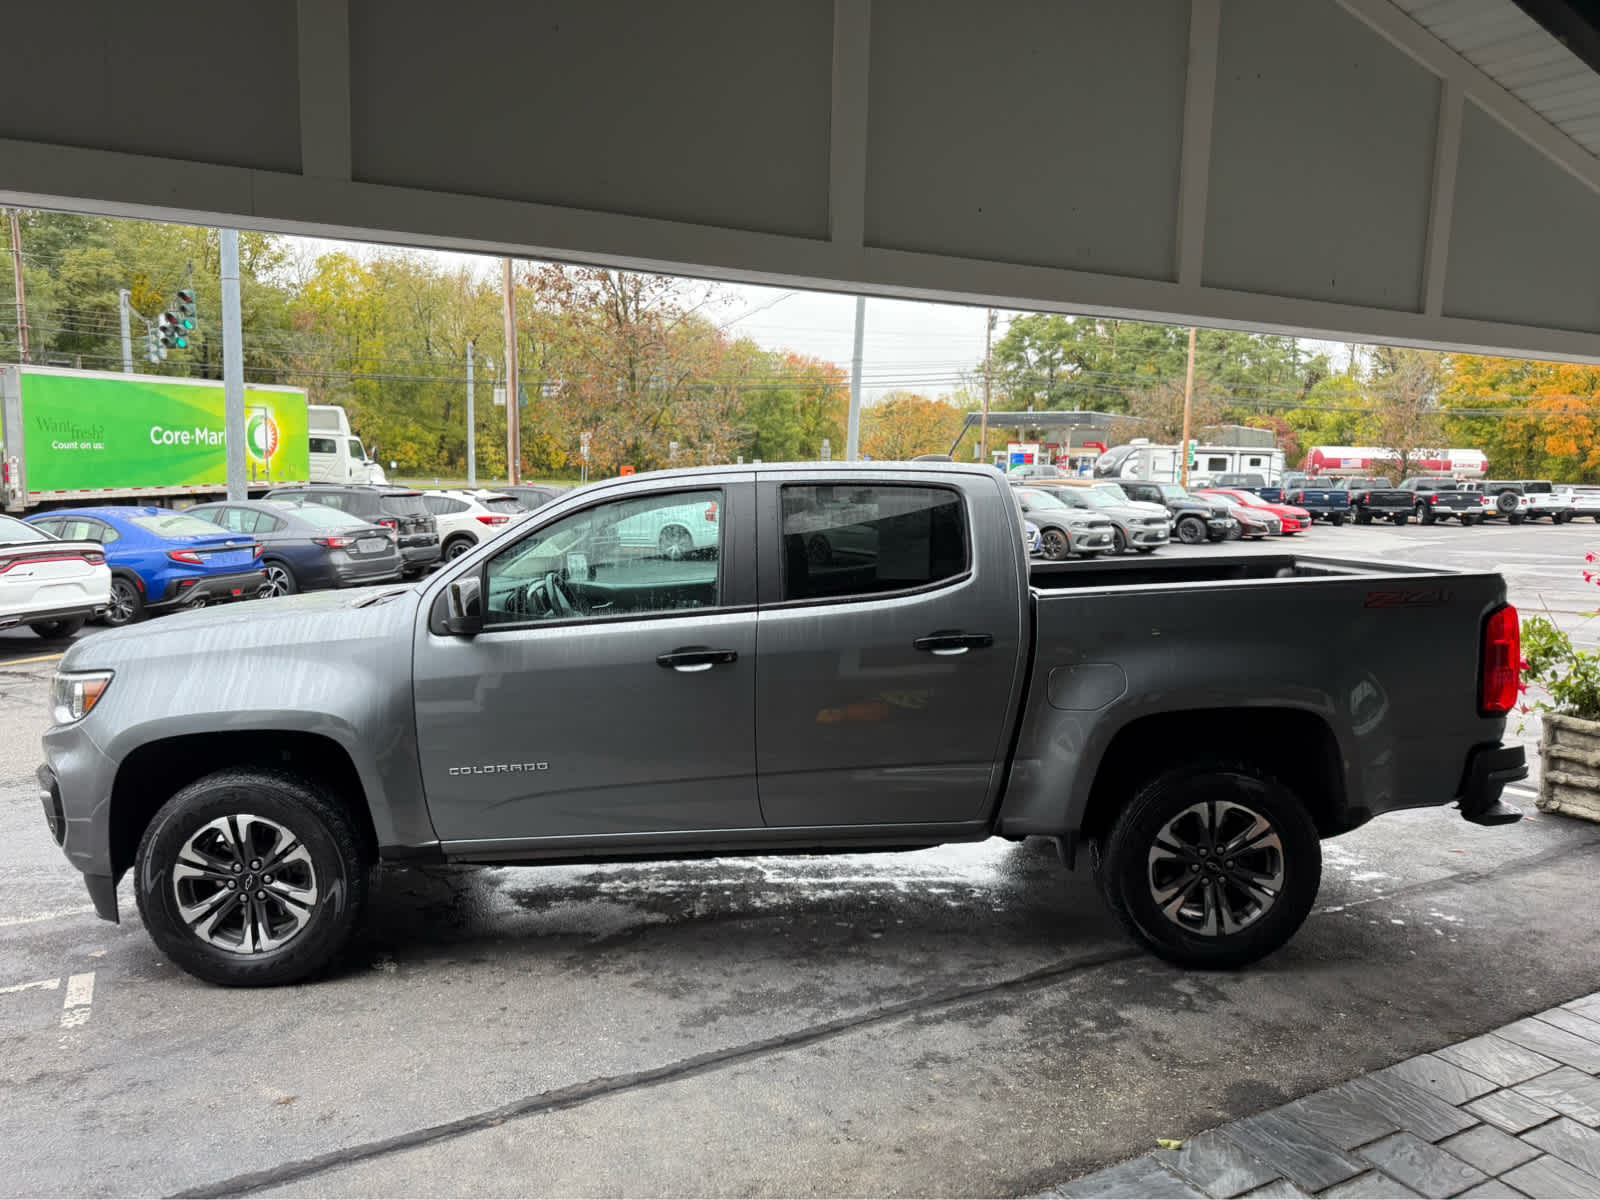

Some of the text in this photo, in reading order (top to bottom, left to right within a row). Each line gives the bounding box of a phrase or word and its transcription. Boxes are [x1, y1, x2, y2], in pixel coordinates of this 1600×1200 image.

[33, 416, 72, 432] Want
[71, 424, 105, 440] fresh?
[51, 440, 79, 449] Count
[449, 762, 549, 775] COLORADO
